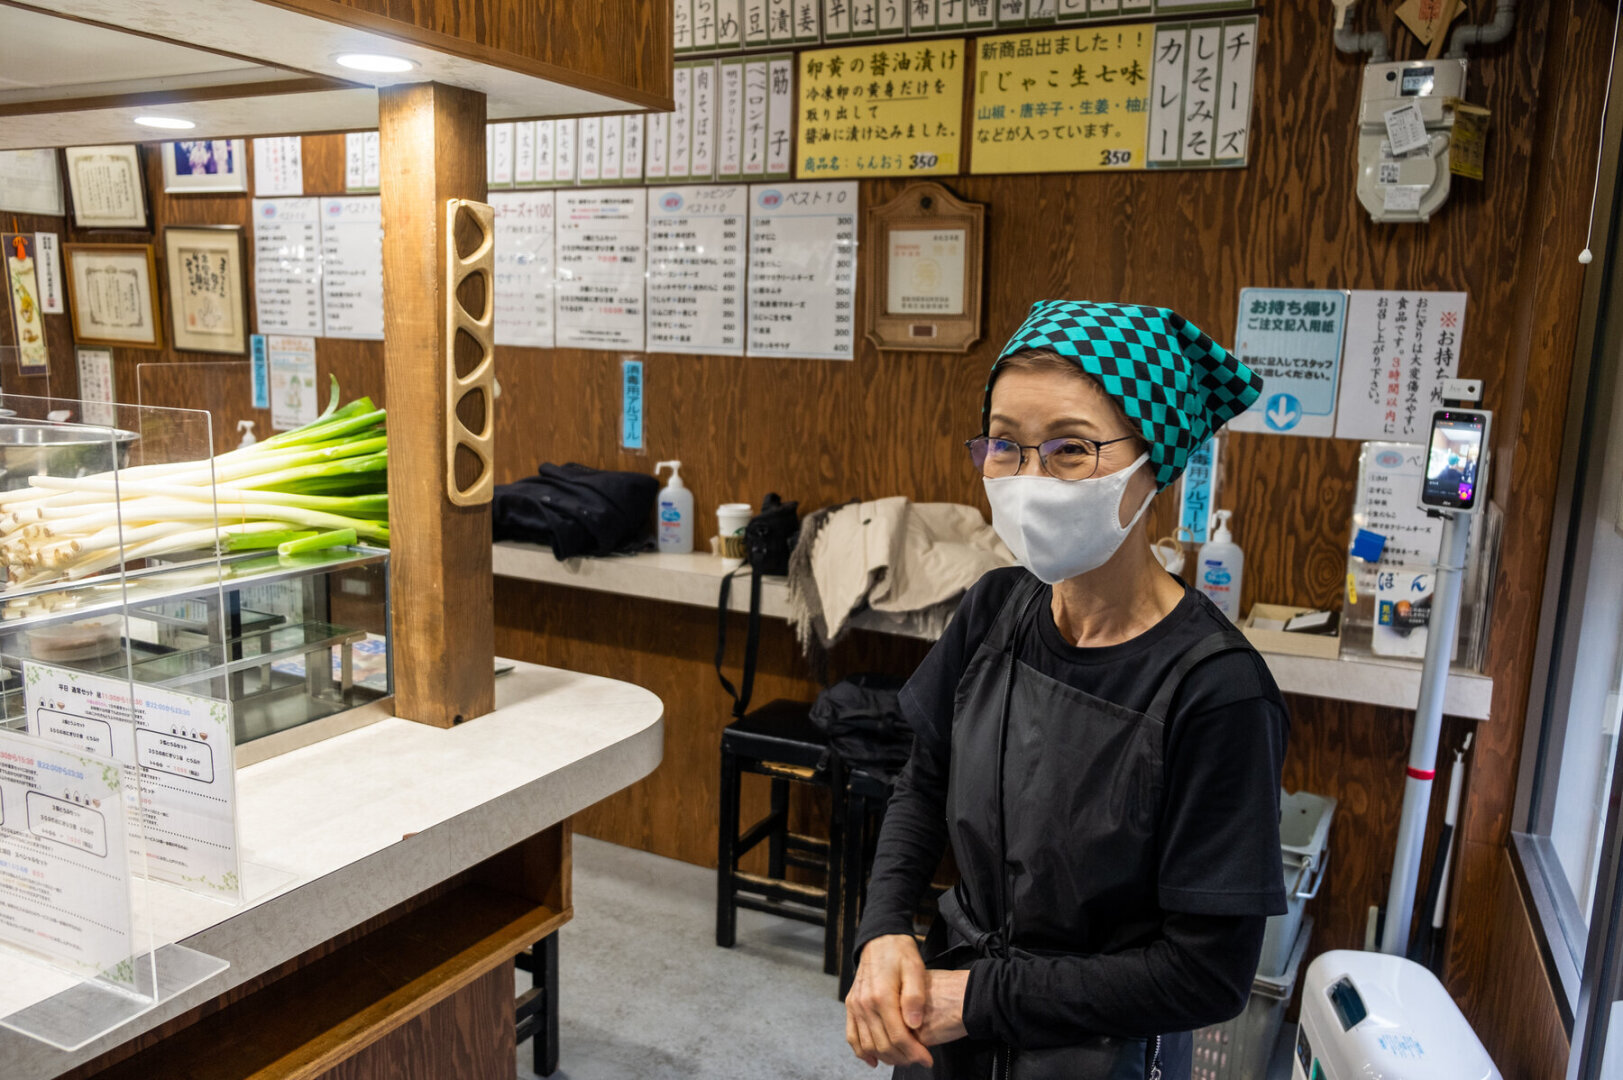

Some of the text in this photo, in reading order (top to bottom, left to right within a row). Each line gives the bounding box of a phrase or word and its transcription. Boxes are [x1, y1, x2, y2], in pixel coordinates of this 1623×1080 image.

[981, 31, 1143, 60] 新商品出ました！！
[806, 49, 958, 80] 卵黄の醤油漬け
[805, 80, 947, 101] 冷凍卵の黄身だけを
[1157, 37, 1182, 156] カレー
[1186, 35, 1214, 156] しそみそ
[1219, 31, 1251, 154] チーズ
[770, 65, 789, 157] 筋子
[805, 105, 880, 122] 取り出して
[804, 119, 957, 145] 醤油に漬け込みました。
[976, 122, 1122, 144] などが入っています。
[1250, 298, 1336, 318] お持ち帰り
[1247, 317, 1335, 335] ご注文記入用紙
[1367, 296, 1389, 404] お召し上がり下さい。
[1402, 296, 1428, 434] おにぎりは大変傷みやすい
